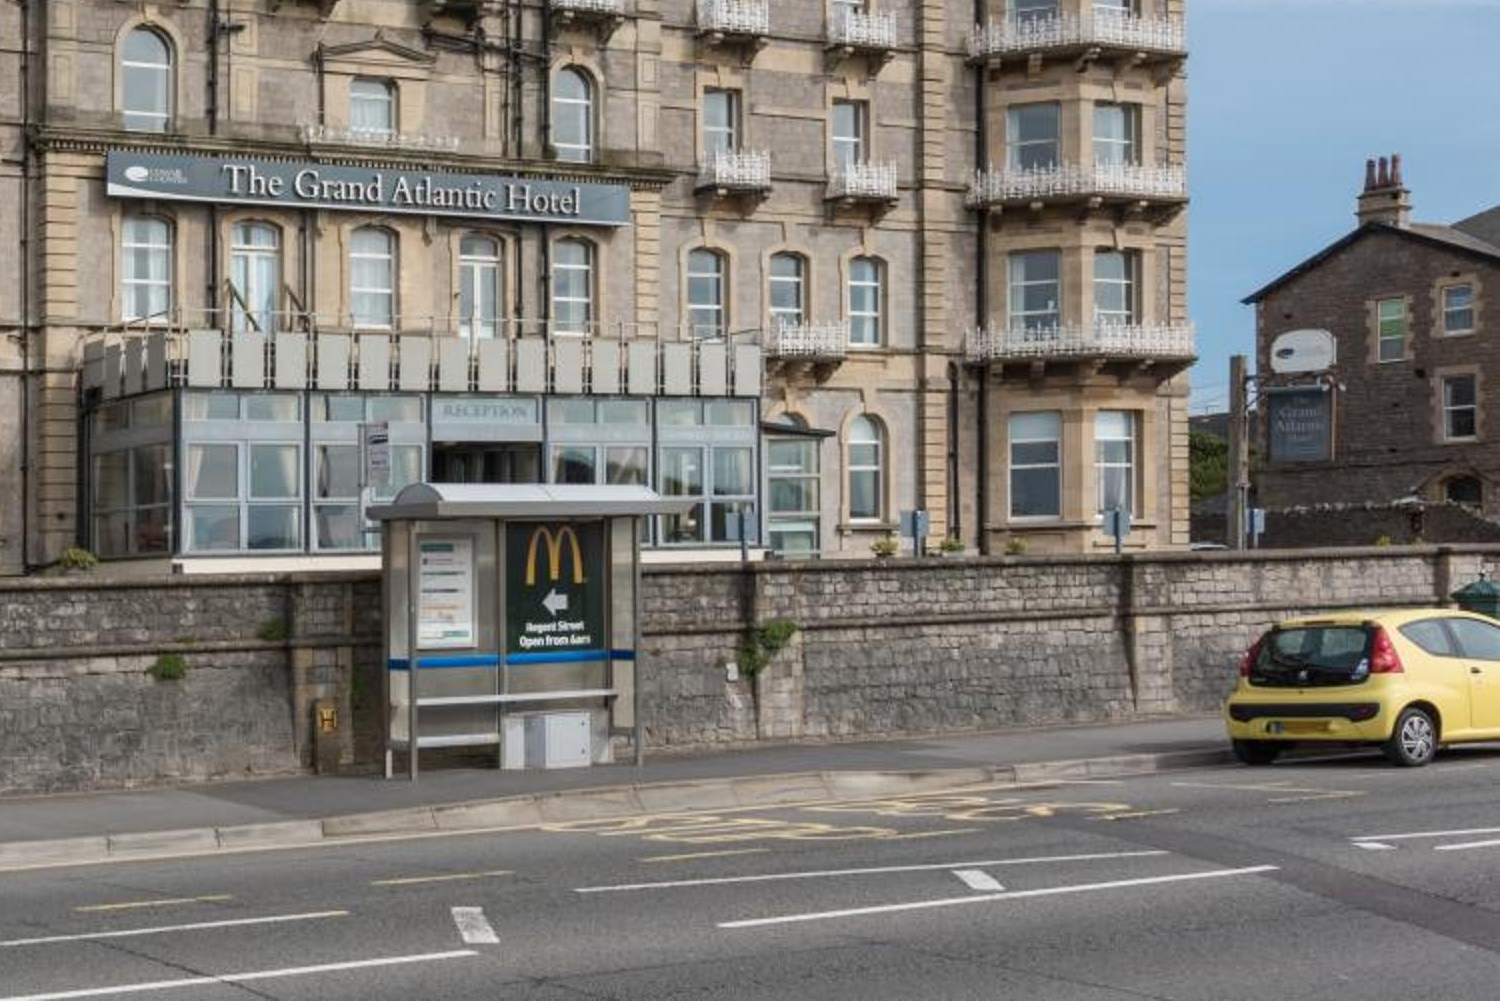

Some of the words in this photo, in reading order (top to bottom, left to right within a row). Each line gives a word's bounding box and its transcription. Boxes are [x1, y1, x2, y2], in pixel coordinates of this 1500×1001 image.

[223, 164, 284, 197] The
[294, 168, 383, 202] Grand
[391, 175, 497, 209] Atlantic
[505, 183, 581, 215] Hotel
[443, 404, 527, 418] RECEPTION
[558, 621, 585, 632] Street
[519, 635, 544, 649] Open
[545, 634, 569, 646] from
[320, 710, 336, 727] H
